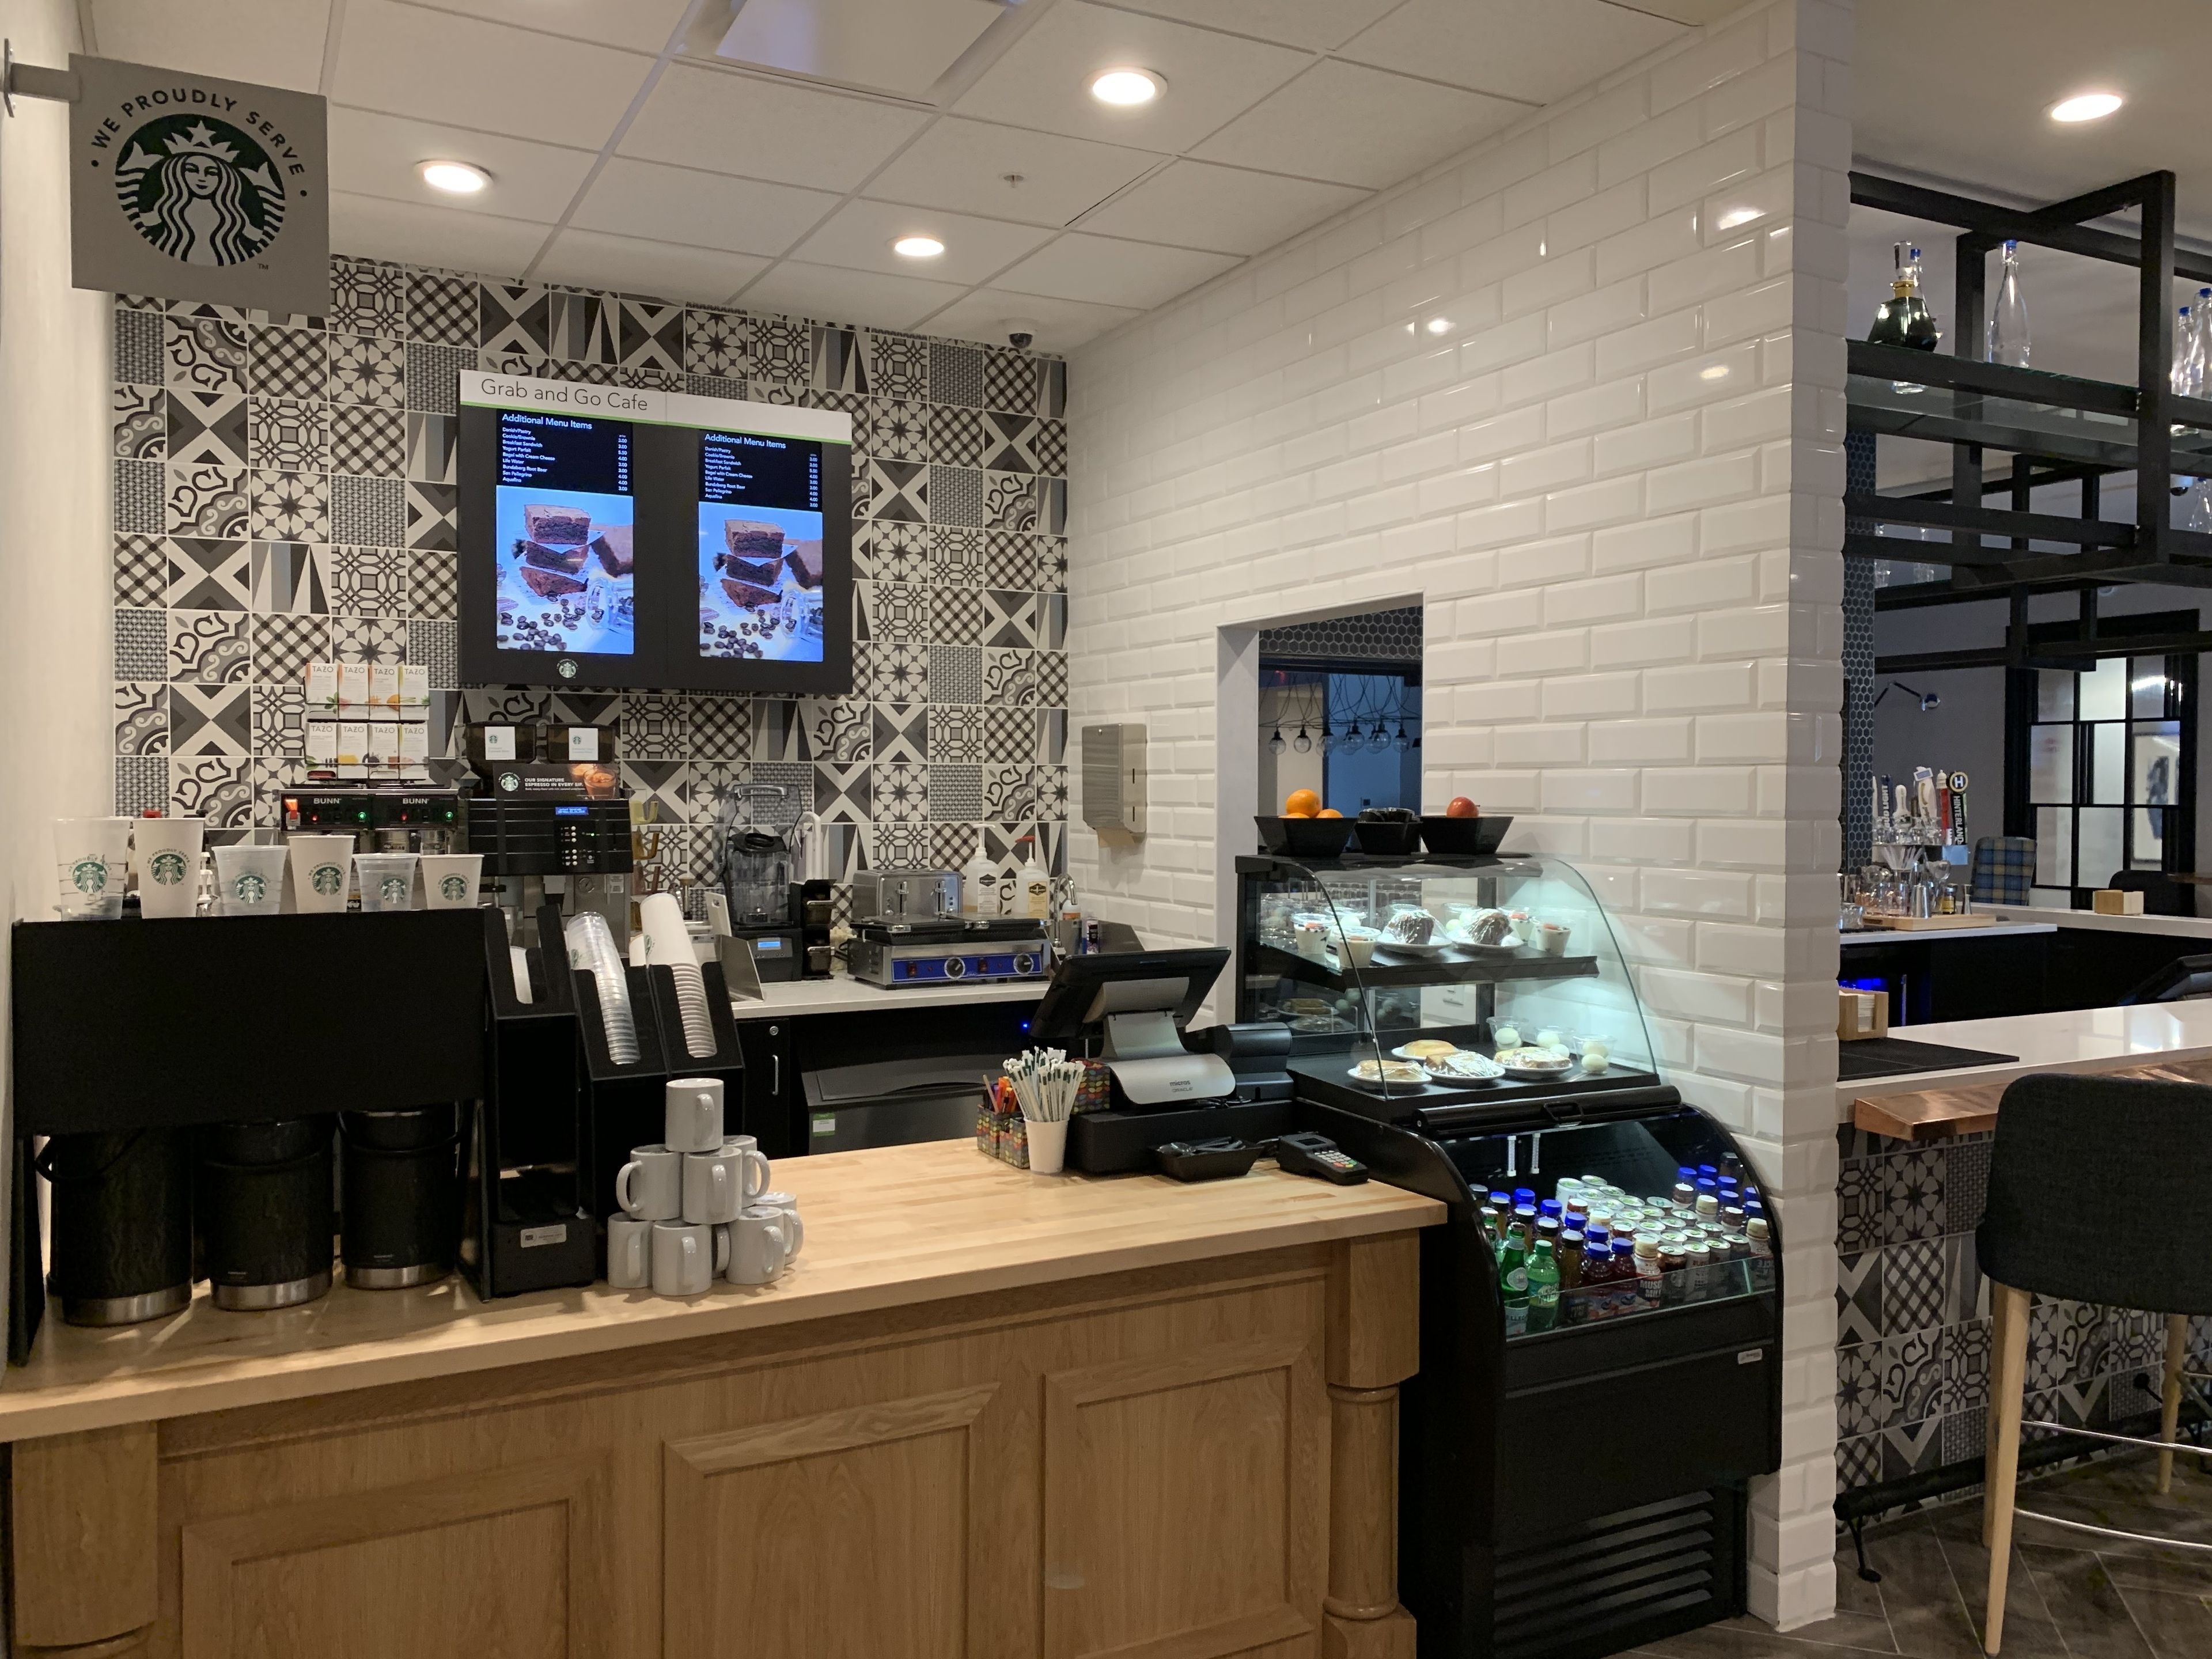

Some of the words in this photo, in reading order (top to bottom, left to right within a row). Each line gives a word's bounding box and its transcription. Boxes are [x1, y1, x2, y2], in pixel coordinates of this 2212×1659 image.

[91, 118, 121, 149] WE
[121, 88, 237, 118] PROUDLY
[245, 111, 305, 176] SERVE
[481, 378, 528, 398] Grab
[534, 387, 567, 402] and
[574, 389, 601, 406] Go
[607, 392, 647, 411] Cafe
[502, 414, 544, 425] Additional
[545, 418, 568, 427] Menu
[570, 421, 593, 430] Items
[704, 434, 742, 444] Additional
[744, 438, 765, 447] Menu
[766, 440, 786, 449] Items
[1955, 776, 1964, 788] H
[1881, 785, 1889, 809] LIGHT
[1953, 796, 1964, 843] HINTERLAND
[151, 848, 177, 857] PROUDLY
